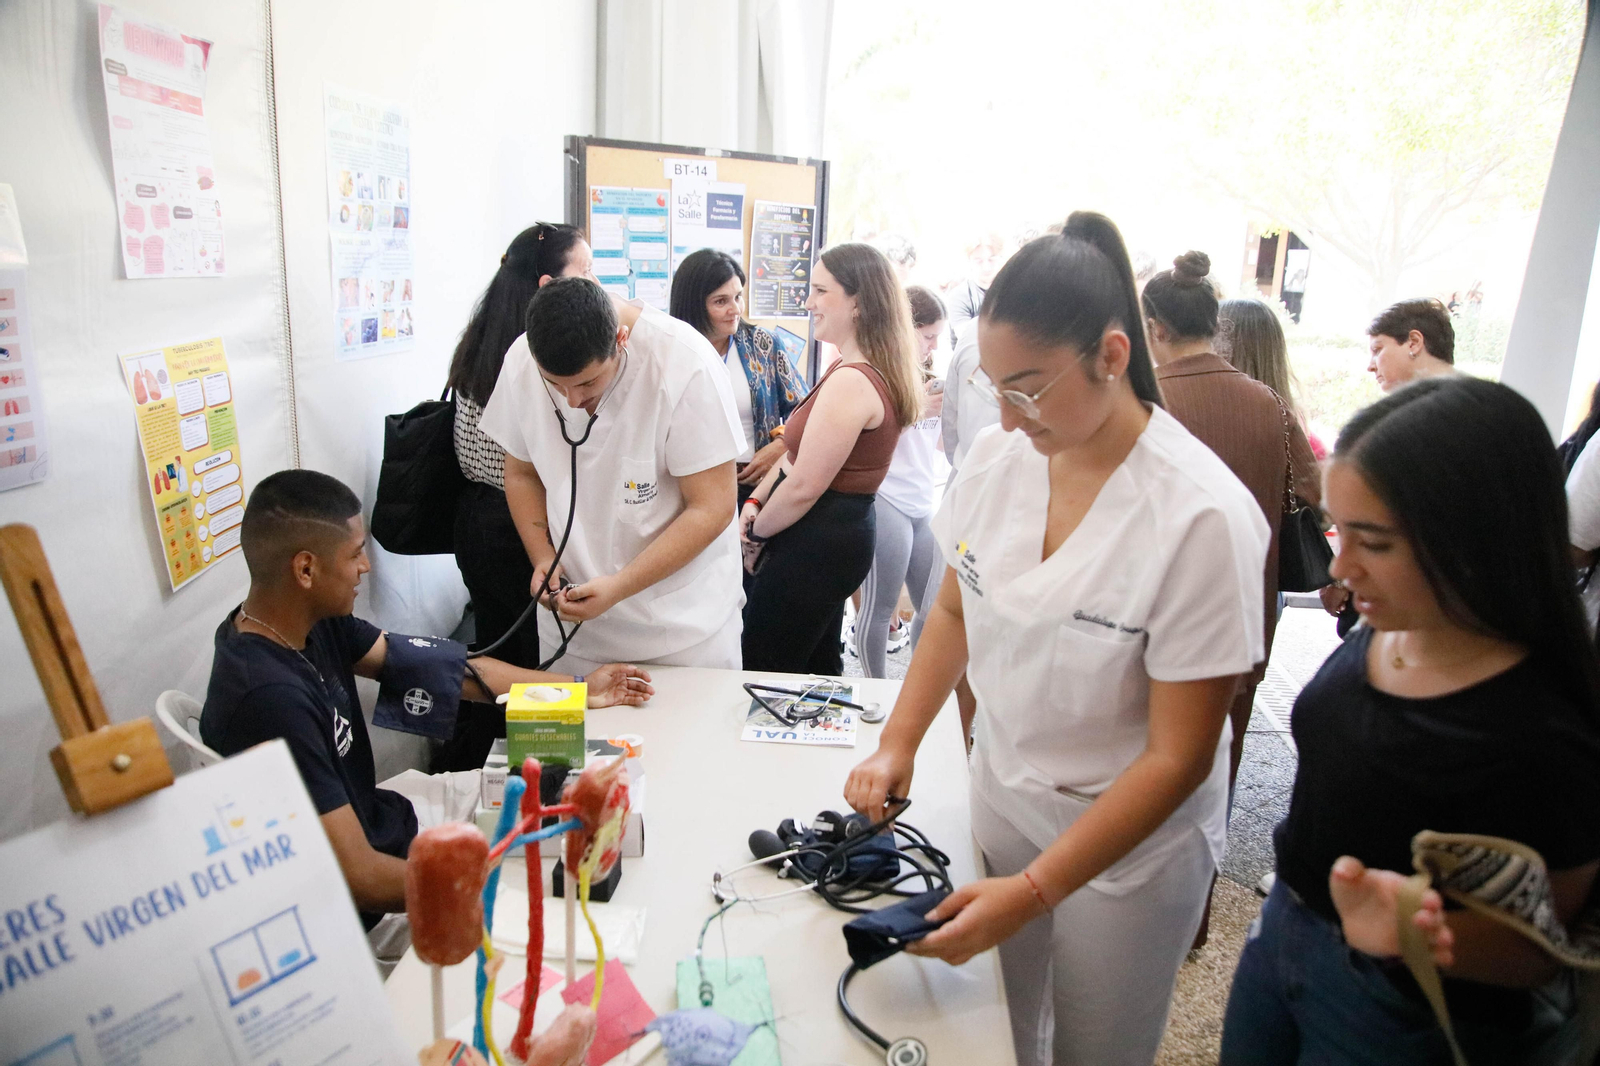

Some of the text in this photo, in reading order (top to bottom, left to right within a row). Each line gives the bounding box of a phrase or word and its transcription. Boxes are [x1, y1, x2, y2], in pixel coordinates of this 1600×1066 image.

[674, 164, 708, 176] BT-14
[677, 195, 689, 206] La
[678, 208, 702, 220] Salle
[752, 729, 798, 740] UAL
[0, 833, 297, 995] ALLE VIRGEN DEL MAR
[0, 893, 66, 950] RES
